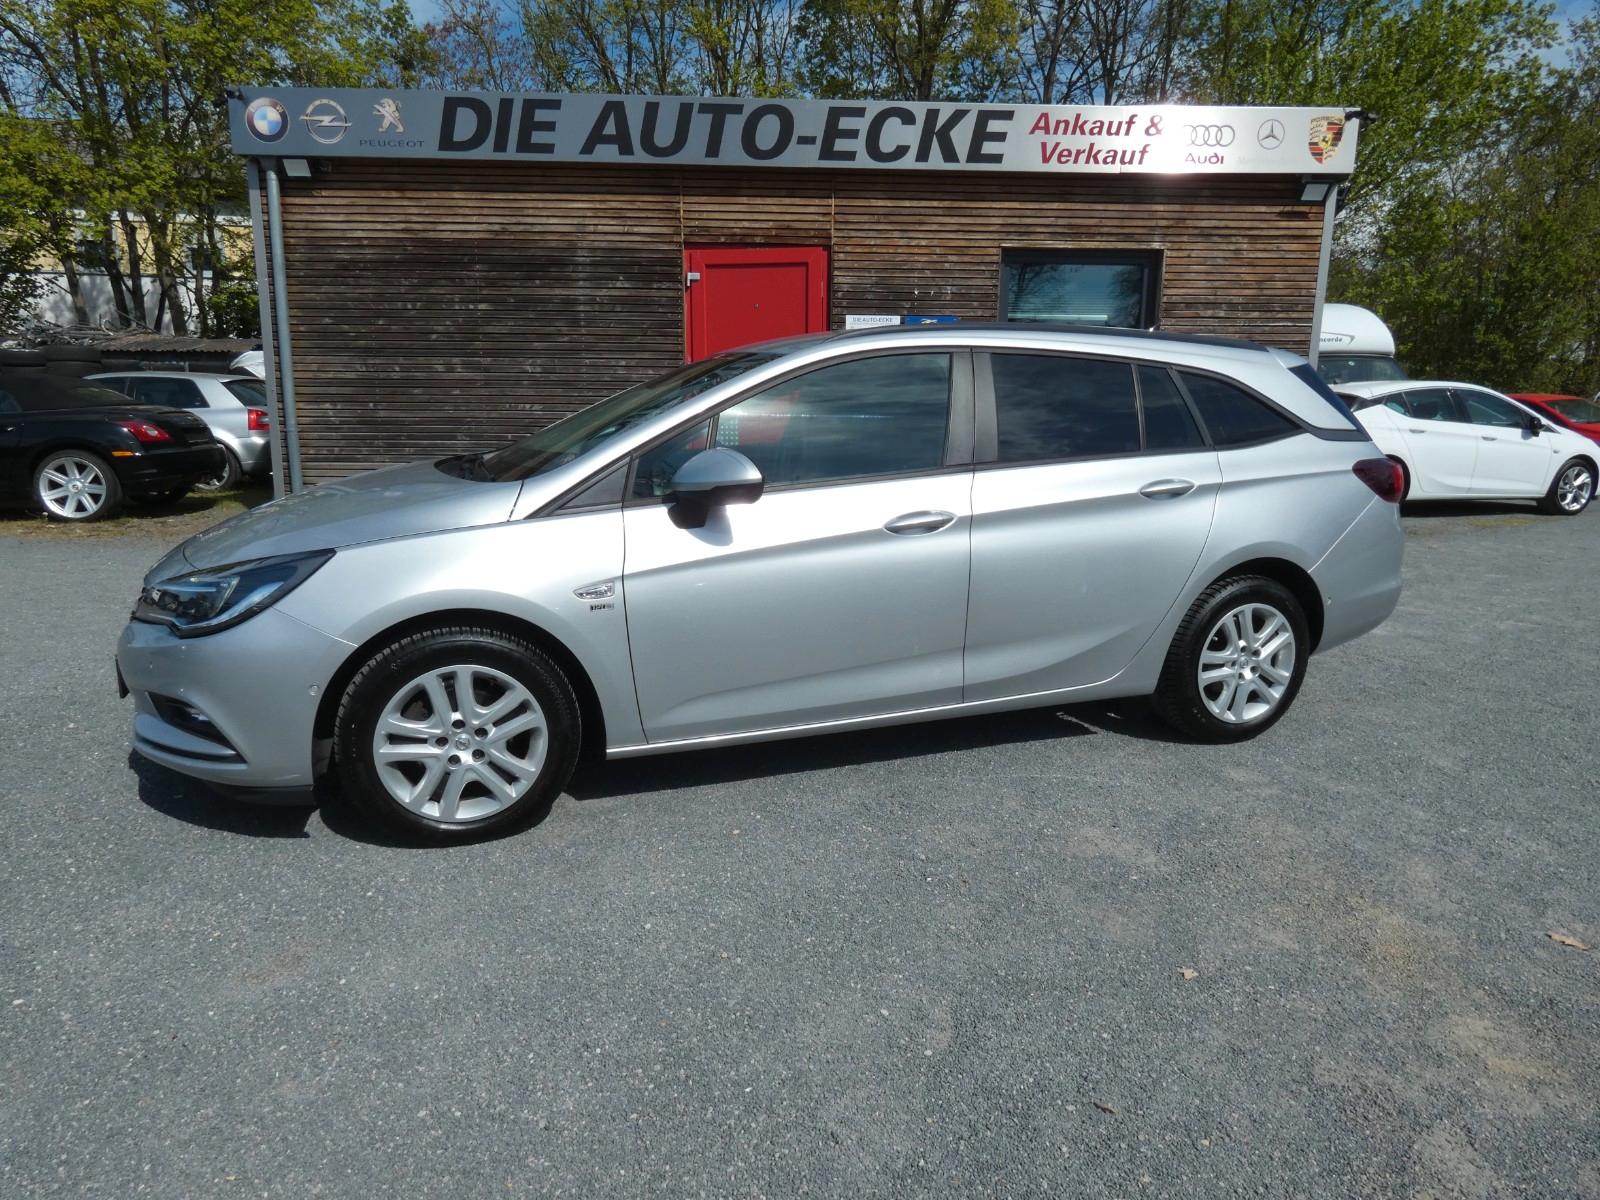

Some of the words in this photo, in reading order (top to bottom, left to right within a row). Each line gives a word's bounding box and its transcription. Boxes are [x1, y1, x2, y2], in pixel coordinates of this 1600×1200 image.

[437, 96, 562, 154] DIE
[579, 100, 1015, 164] AUTO-ECKE
[1029, 112, 1138, 136] Ankauf
[1144, 114, 1164, 136] &
[359, 139, 425, 148] PEUGEOT
[1040, 142, 1151, 165] Verkauf
[1184, 152, 1225, 165] Audi
